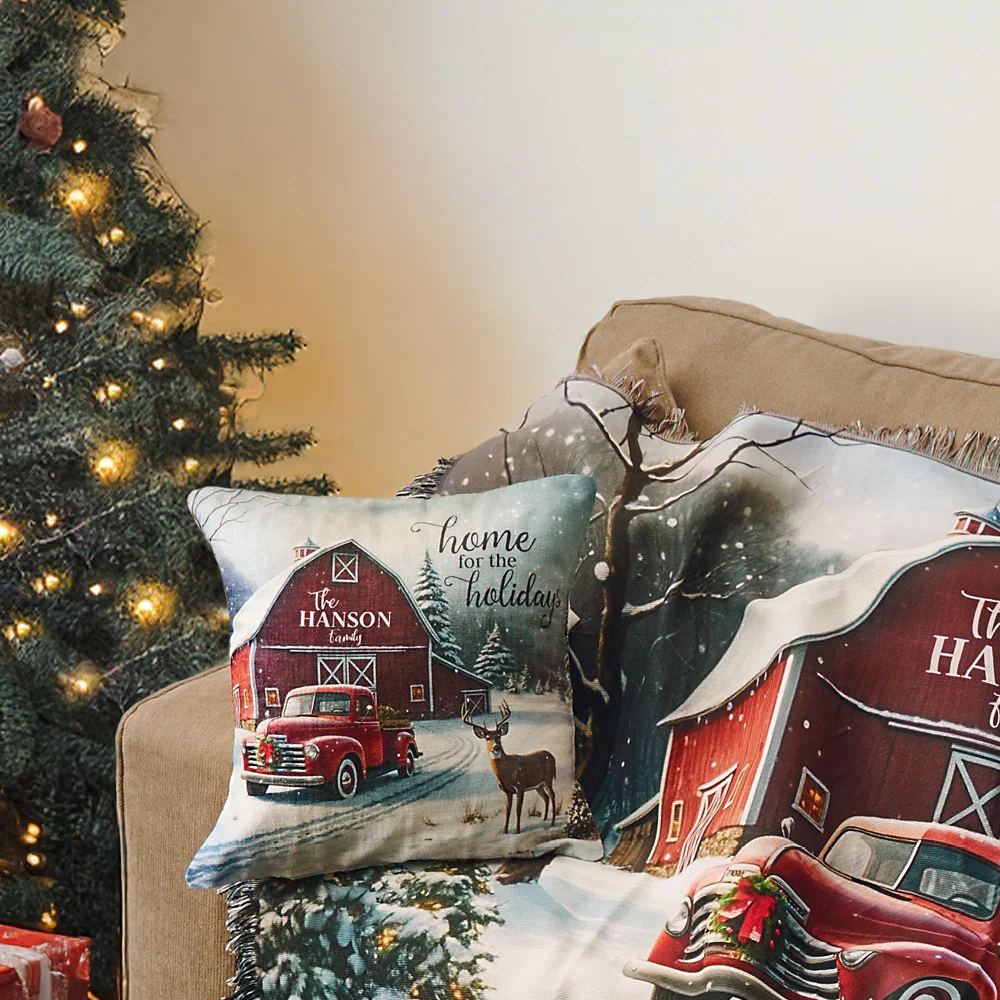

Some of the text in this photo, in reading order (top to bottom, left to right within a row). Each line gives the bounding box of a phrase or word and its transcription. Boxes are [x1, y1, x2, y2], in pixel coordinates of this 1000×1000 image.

[410, 515, 537, 555] home
[458, 553, 517, 569] for the
[307, 587, 340, 611] The
[443, 568, 561, 629] holidays
[299, 610, 392, 628] HANSON
